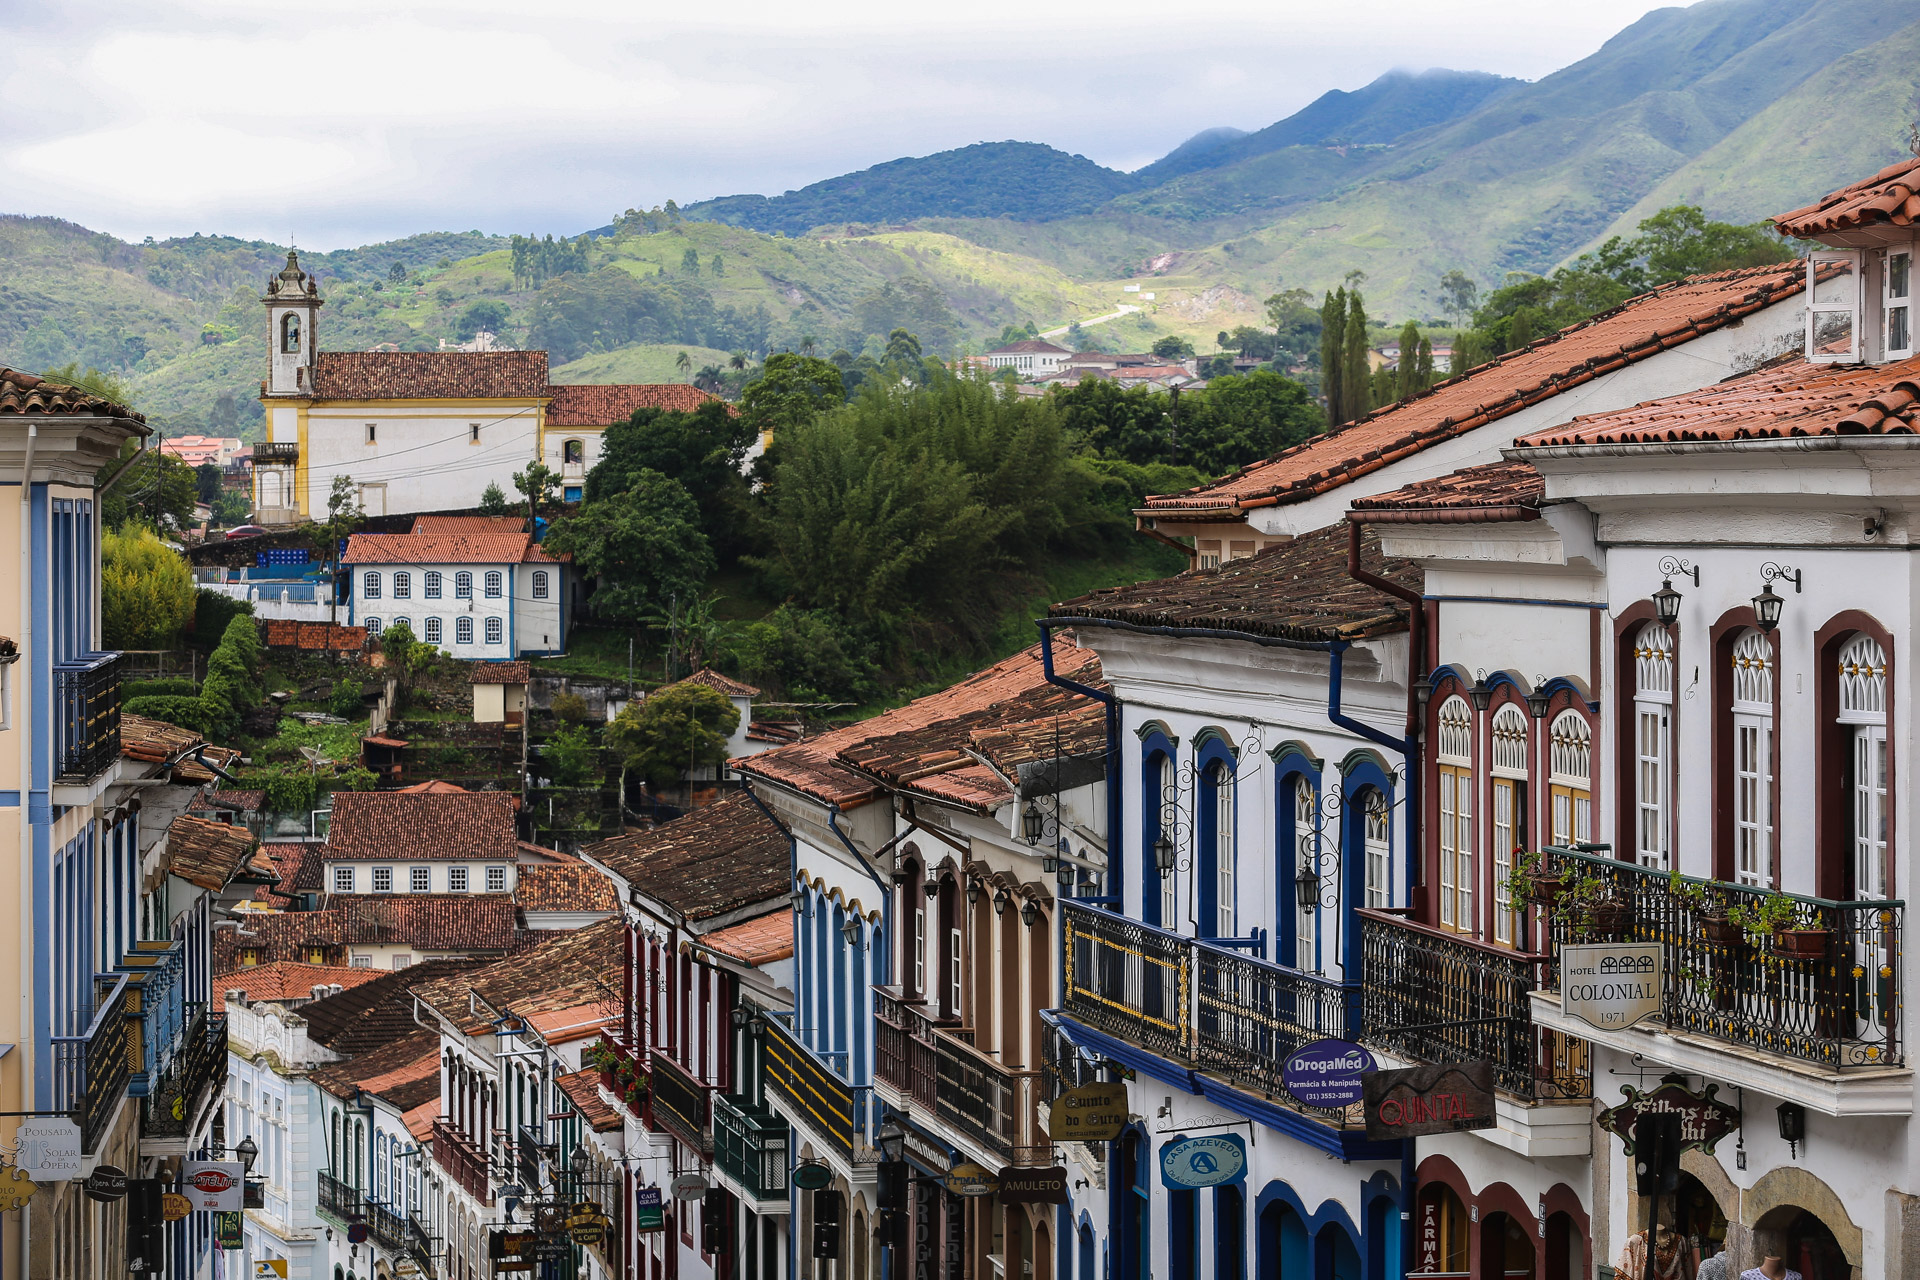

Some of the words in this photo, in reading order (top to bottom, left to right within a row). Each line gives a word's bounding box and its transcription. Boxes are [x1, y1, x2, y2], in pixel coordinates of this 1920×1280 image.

[1570, 967, 1597, 975] HOTEL
[1570, 983, 1656, 1001] COLONIAL
[1600, 1012, 1625, 1023] 1971
[1295, 1057, 1362, 1074] DrogaMed
[1289, 1080, 1320, 1088] Farmácia
[1329, 1079, 1362, 1088] Manipulaç
[1065, 1095, 1111, 1108] Quinto
[1379, 1093, 1475, 1127] QUINTAL
[1703, 1106, 1722, 1120] de
[1065, 1114, 1079, 1126] do
[1086, 1112, 1120, 1126] Ouro
[1453, 1115, 1492, 1129] BISTRÔ
[24, 1127, 74, 1136] POUSADA
[1066, 1129, 1109, 1137] restaurante
[46, 1148, 77, 1157] SOLAR
[1166, 1143, 1190, 1165] CASA
[1192, 1139, 1240, 1158] AZEVEDO
[40, 1158, 78, 1169] ÓPERA
[185, 1174, 240, 1188] SATÉLITE
[1004, 1180, 1061, 1191] AMULETO
[163, 1197, 184, 1208] TICA
